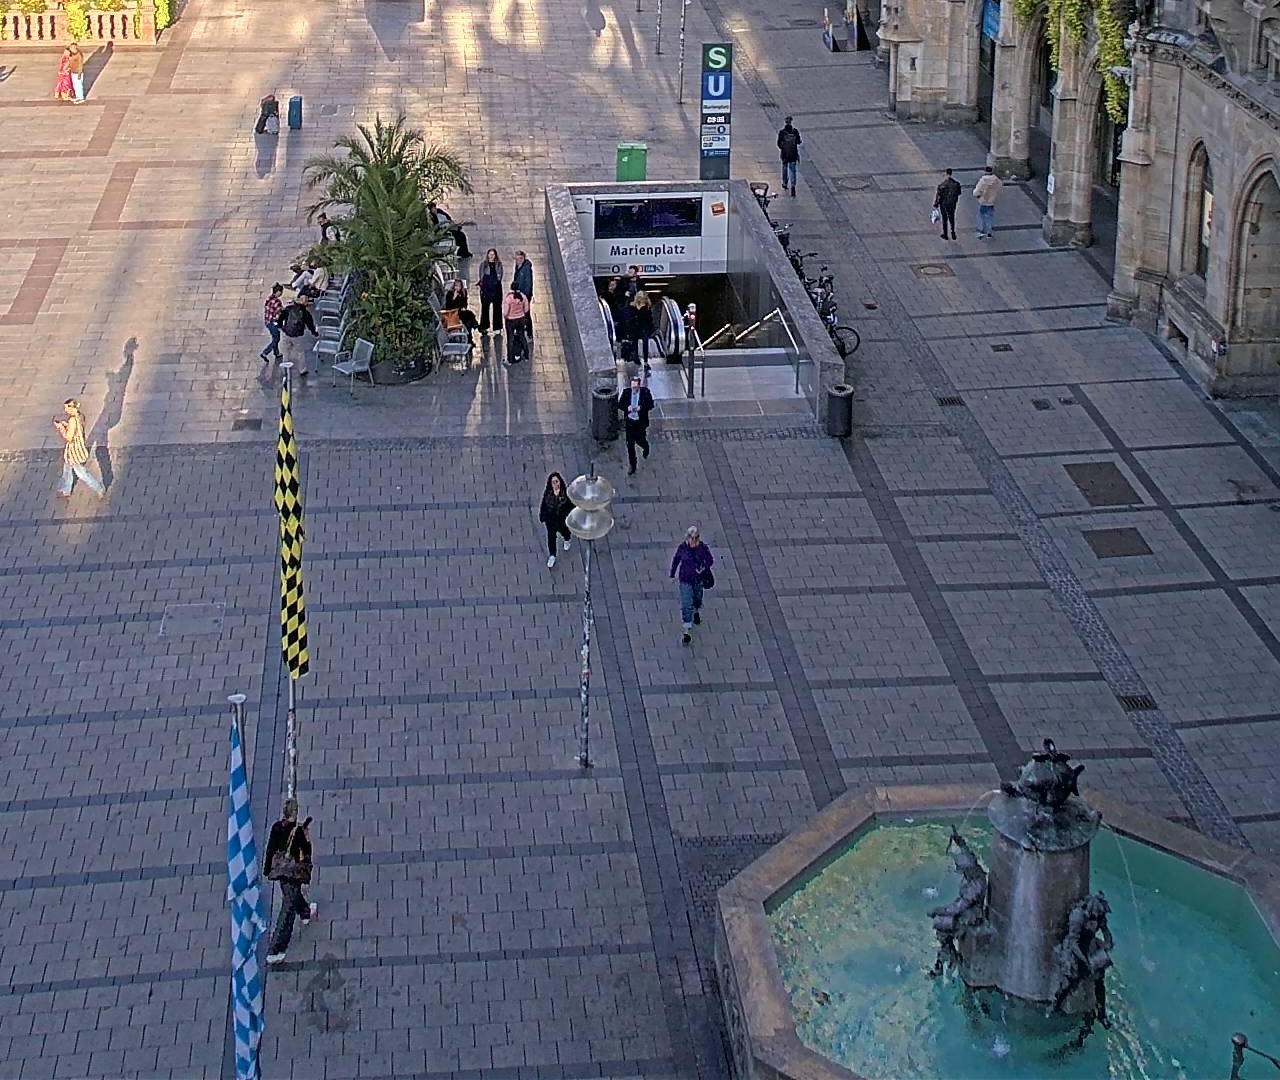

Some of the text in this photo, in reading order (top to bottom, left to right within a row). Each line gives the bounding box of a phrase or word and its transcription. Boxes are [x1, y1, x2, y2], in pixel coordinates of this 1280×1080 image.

[708, 46, 727, 69] S
[708, 75, 725, 97] U
[610, 244, 686, 258] Marienplatz
